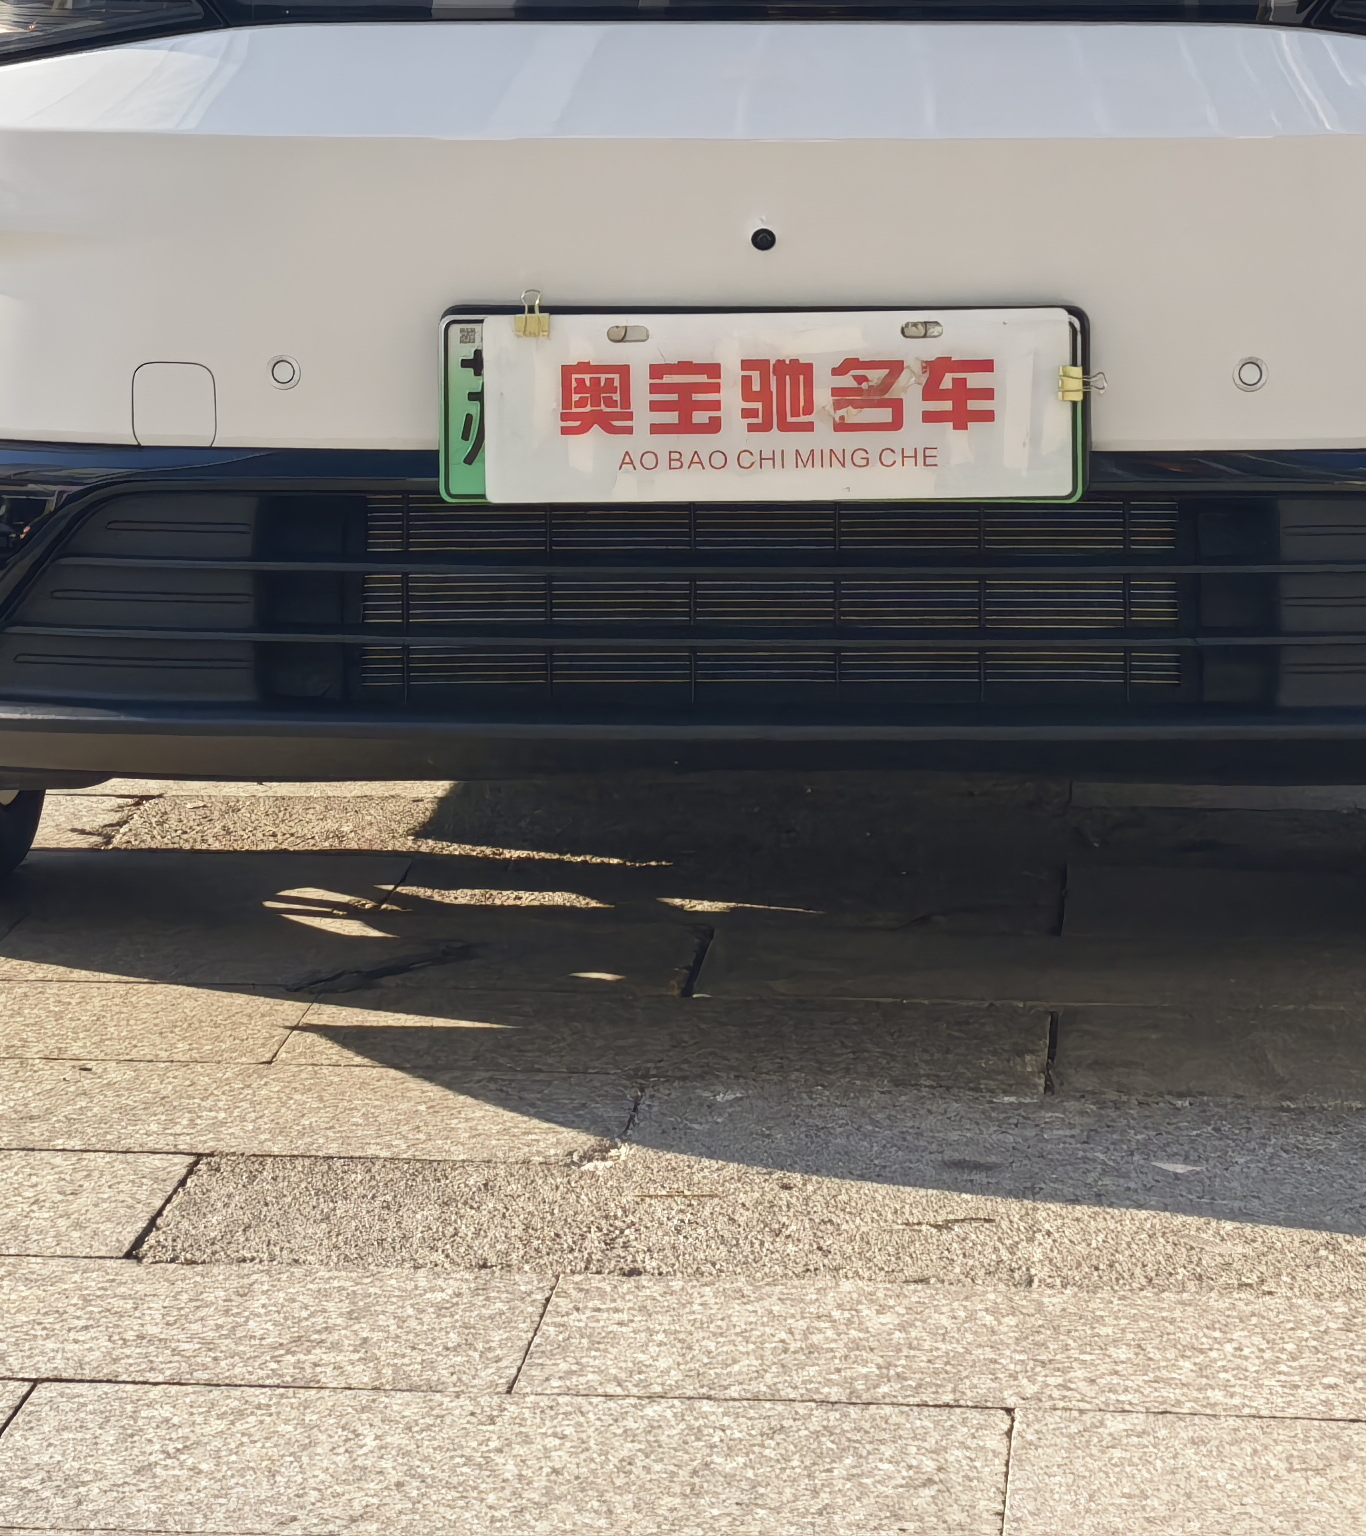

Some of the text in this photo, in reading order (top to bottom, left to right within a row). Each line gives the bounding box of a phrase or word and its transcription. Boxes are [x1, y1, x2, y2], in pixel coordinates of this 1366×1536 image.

[560, 357, 996, 436] 奥宝驰名车
[619, 447, 939, 471] AO BAO CHI MING CHE
